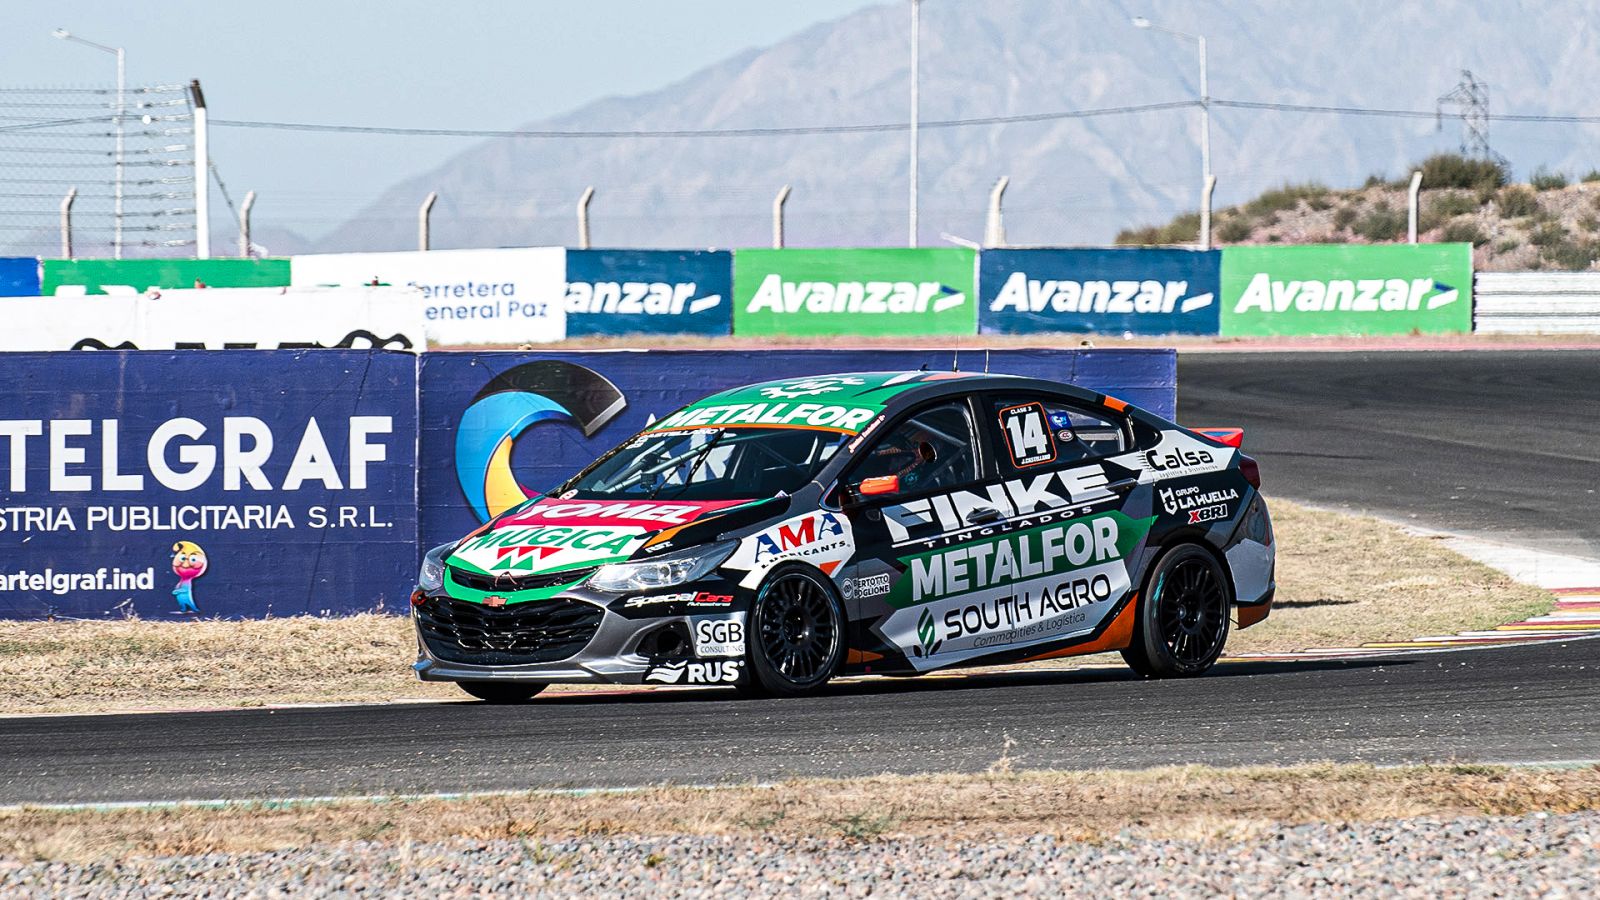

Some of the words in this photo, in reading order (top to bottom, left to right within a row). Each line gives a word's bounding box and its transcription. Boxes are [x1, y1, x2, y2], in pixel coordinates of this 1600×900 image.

[408, 282, 515, 298] erretera
[565, 282, 697, 315] anzar
[746, 274, 941, 314] Avanzar
[990, 272, 1187, 313] Avanzar
[1233, 273, 1434, 313] Avanzar
[425, 301, 500, 320] eneral
[508, 301, 547, 318] Paz
[656, 403, 875, 432] METALFOR
[1010, 407, 1027, 415] CLASE
[1006, 412, 1048, 458] 14
[1145, 447, 1214, 471] Calsa
[881, 463, 1115, 542] FINKE
[1175, 486, 1200, 497] GRUPO
[1178, 496, 1197, 509] LA
[1195, 488, 1239, 506] HUELLA
[87, 505, 295, 531] PUBLICITARIA
[308, 506, 393, 528] S.R.L.
[514, 503, 702, 524] YOMEL
[1188, 503, 1228, 524] XBRI
[755, 513, 844, 563] AMA
[923, 506, 1093, 549] TINGLADOS
[911, 516, 1120, 601] METALFOR
[854, 575, 889, 588] BERTOTTO
[854, 585, 890, 598] BOGLIONE
[944, 592, 1032, 640] SOUTH
[1040, 574, 1111, 617] AGRO
[701, 623, 742, 644] SGB
[973, 625, 1037, 648] Commodities
[1038, 622, 1044, 632] &
[1046, 612, 1086, 631] Logística
[701, 645, 744, 654] CONSULTING
